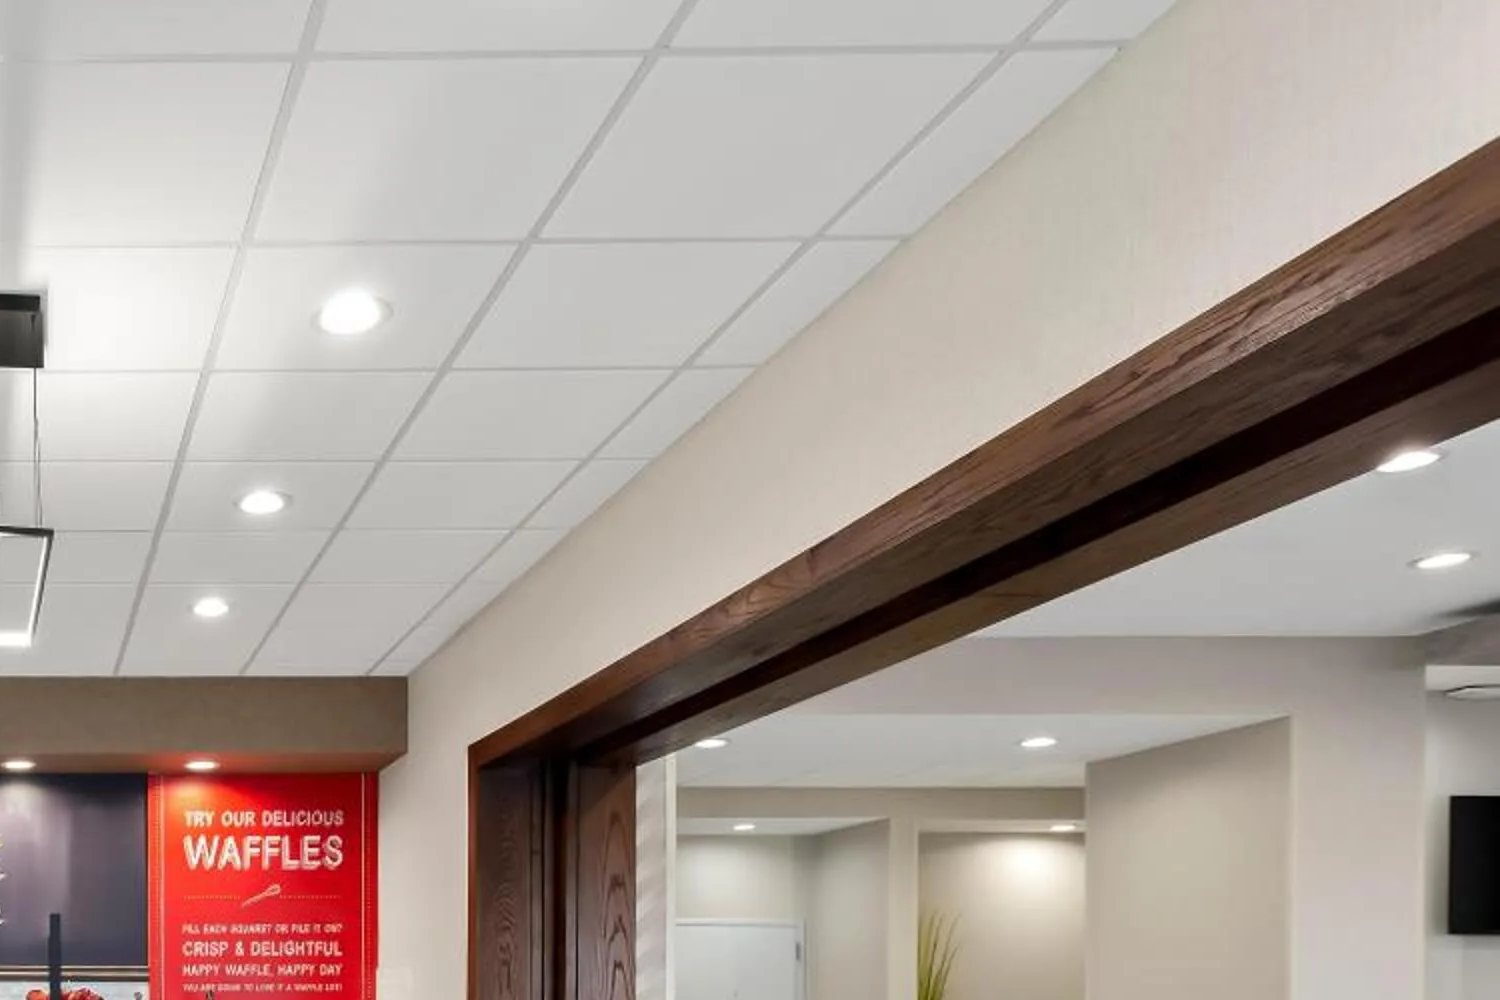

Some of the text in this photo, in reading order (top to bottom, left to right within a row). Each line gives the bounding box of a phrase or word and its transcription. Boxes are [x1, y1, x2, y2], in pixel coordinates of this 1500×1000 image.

[184, 810, 344, 827] TRY OUR DELICIOUS
[182, 834, 344, 871] WAFFLES
[182, 940, 343, 957] CRISP & DELIGHTFUL
[182, 963, 221, 977] HAPPY
[277, 963, 315, 977] HAPPY
[319, 963, 343, 977] DAY
